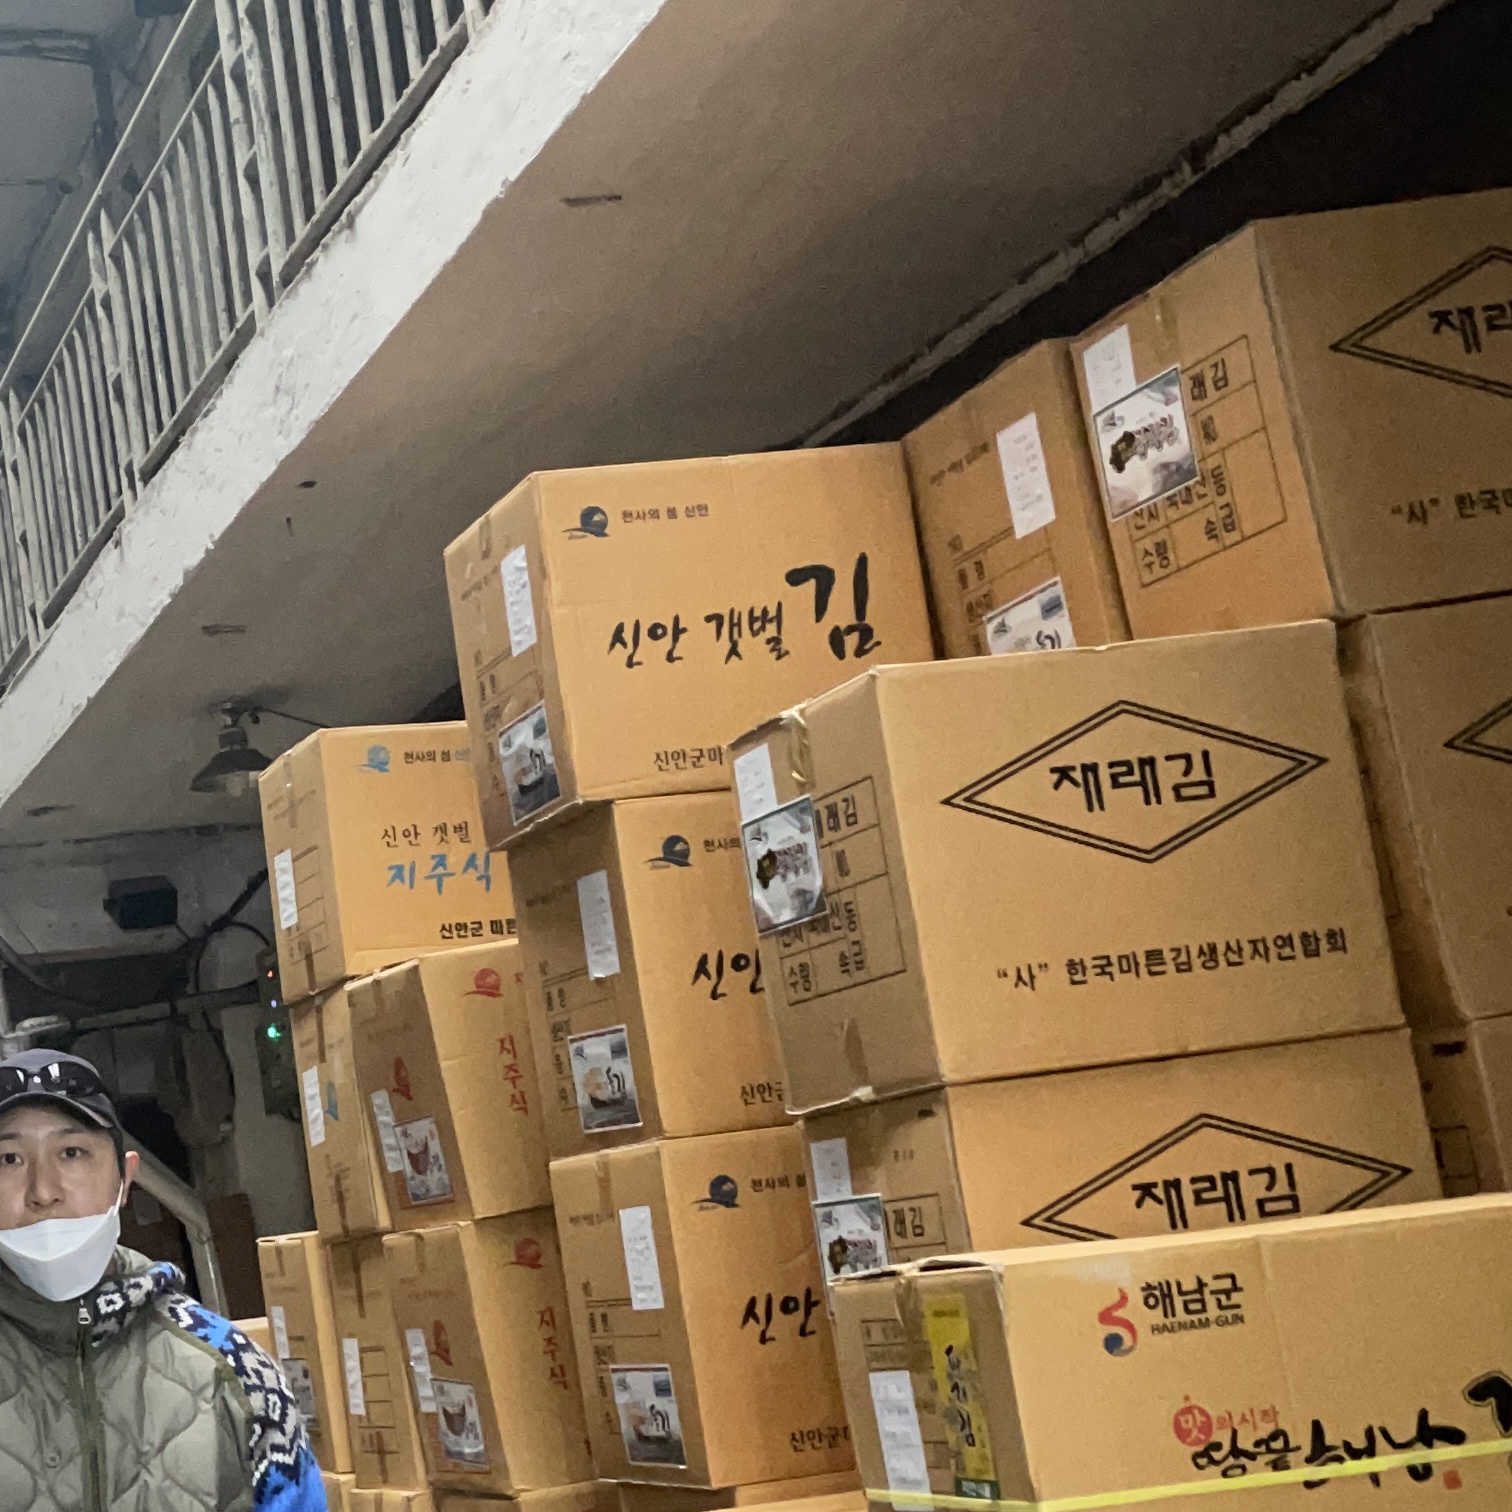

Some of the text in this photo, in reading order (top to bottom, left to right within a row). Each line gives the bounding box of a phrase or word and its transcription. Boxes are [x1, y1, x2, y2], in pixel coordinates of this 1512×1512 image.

[1189, 357, 1229, 402] 래김
[607, 613, 688, 669] 신안
[703, 600, 790, 665] 갯벌
[784, 551, 882, 661] 김
[1049, 749, 1217, 813] 재래김
[380, 820, 473, 849] 신안 갯벌
[386, 850, 493, 897] 지주식
[438, 919, 484, 940] 신안군
[1065, 926, 1349, 987] 한국마른김생산자연합회
[1131, 1161, 1302, 1231] 재래김
[739, 1285, 822, 1346] 신안
[1140, 1272, 1244, 1320] 해남군
[1150, 1313, 1246, 1336] HAENAM-GUN
